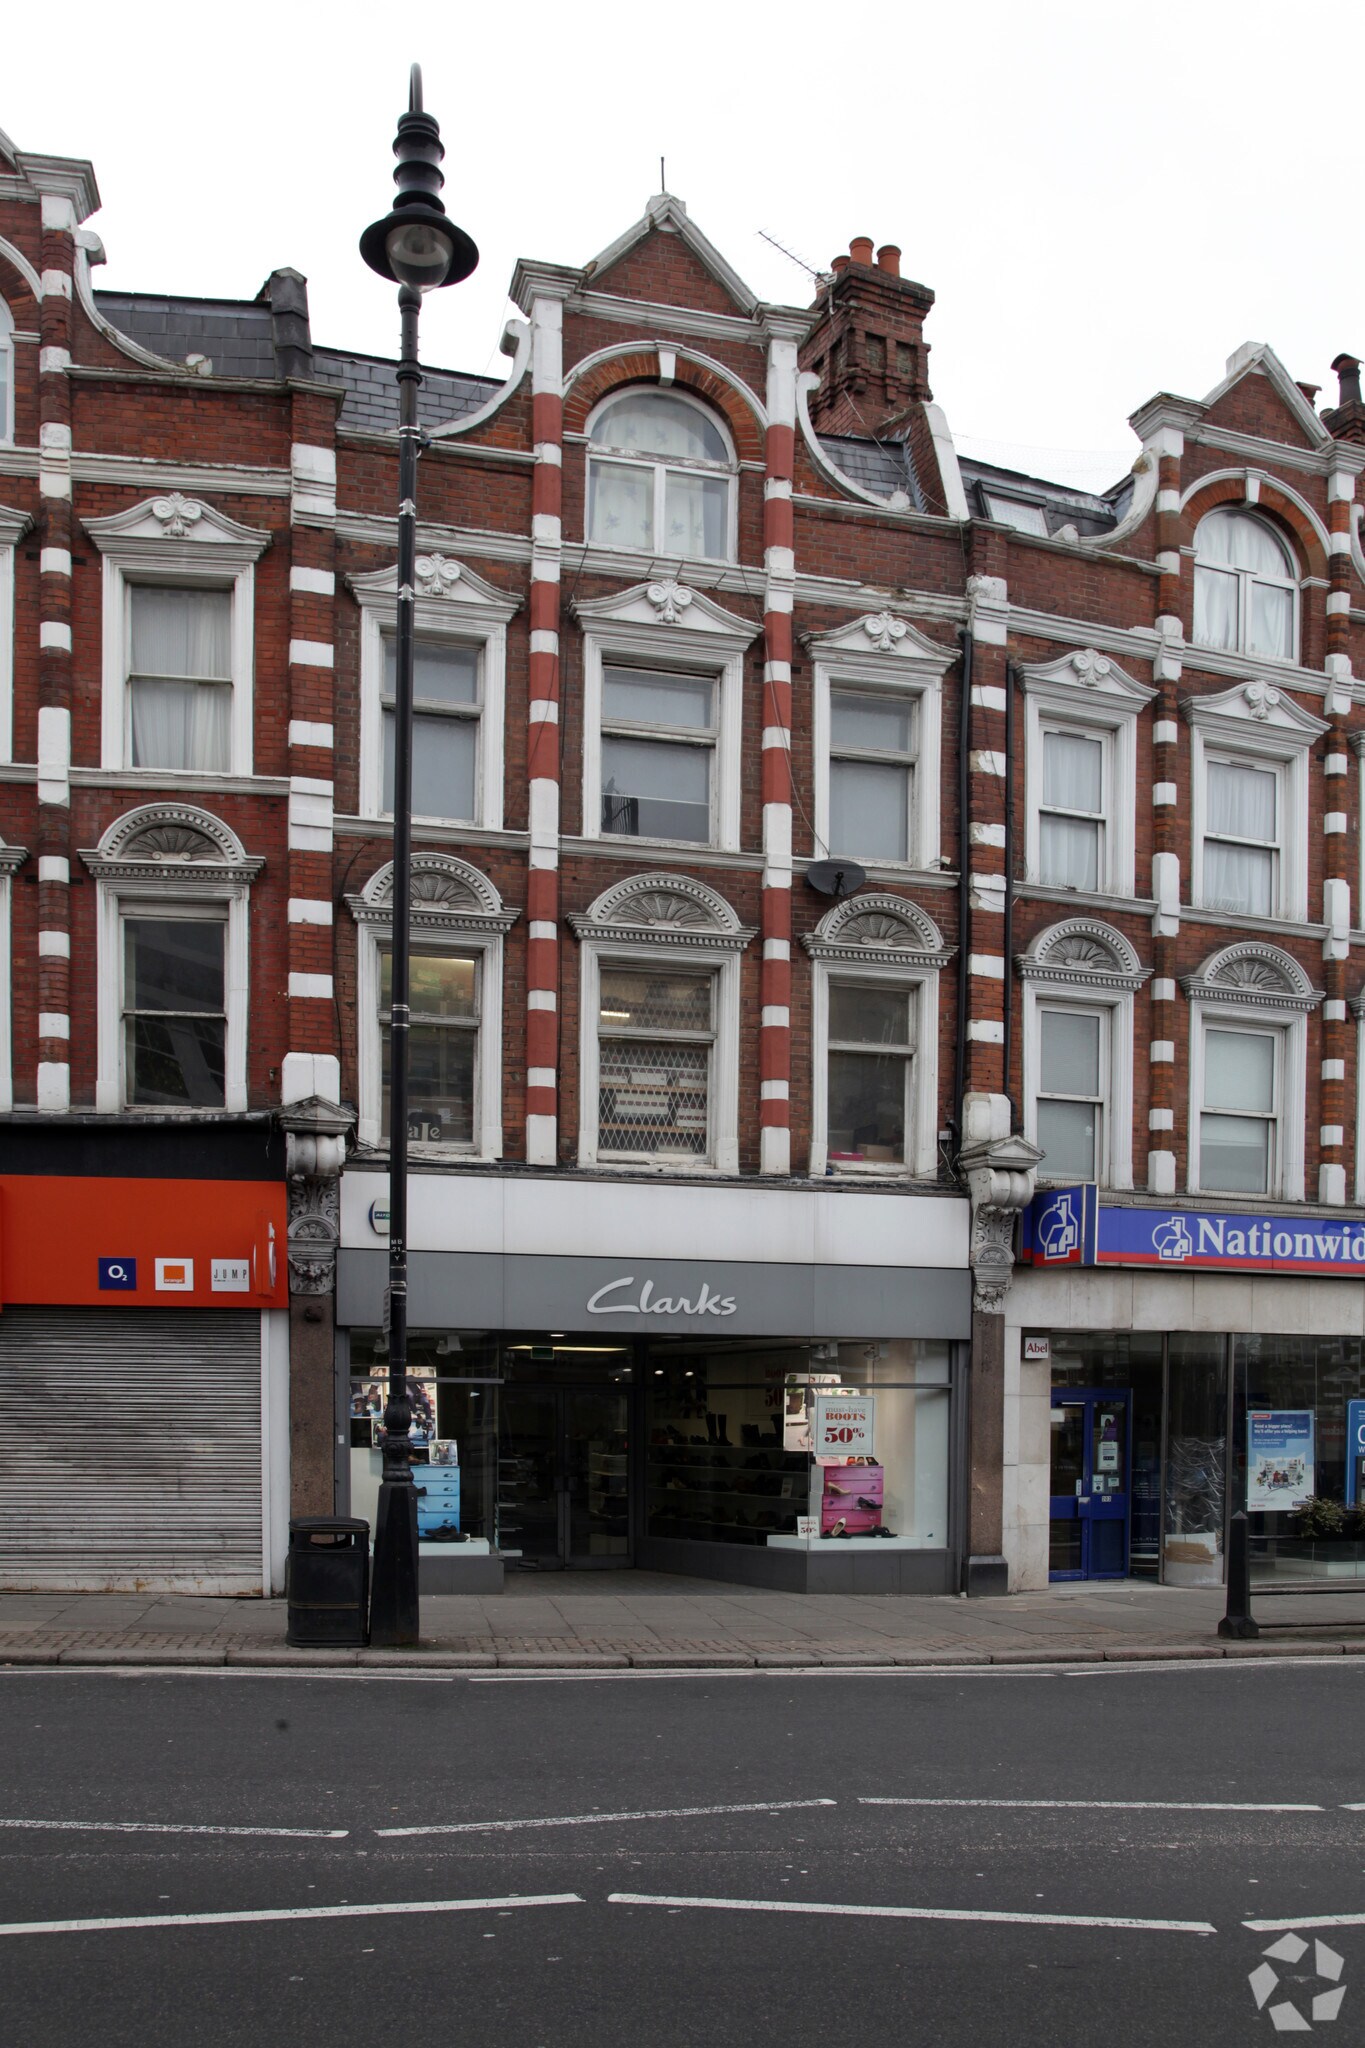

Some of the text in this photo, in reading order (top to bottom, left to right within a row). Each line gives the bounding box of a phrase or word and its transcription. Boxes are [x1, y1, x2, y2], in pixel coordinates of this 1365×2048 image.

[213, 1269, 247, 1279] JUMP
[586, 1276, 738, 1316] Clarks
[1026, 1342, 1048, 1353] Abel
[825, 1412, 866, 1421] BOOTS
[824, 1427, 865, 1444] 50%
